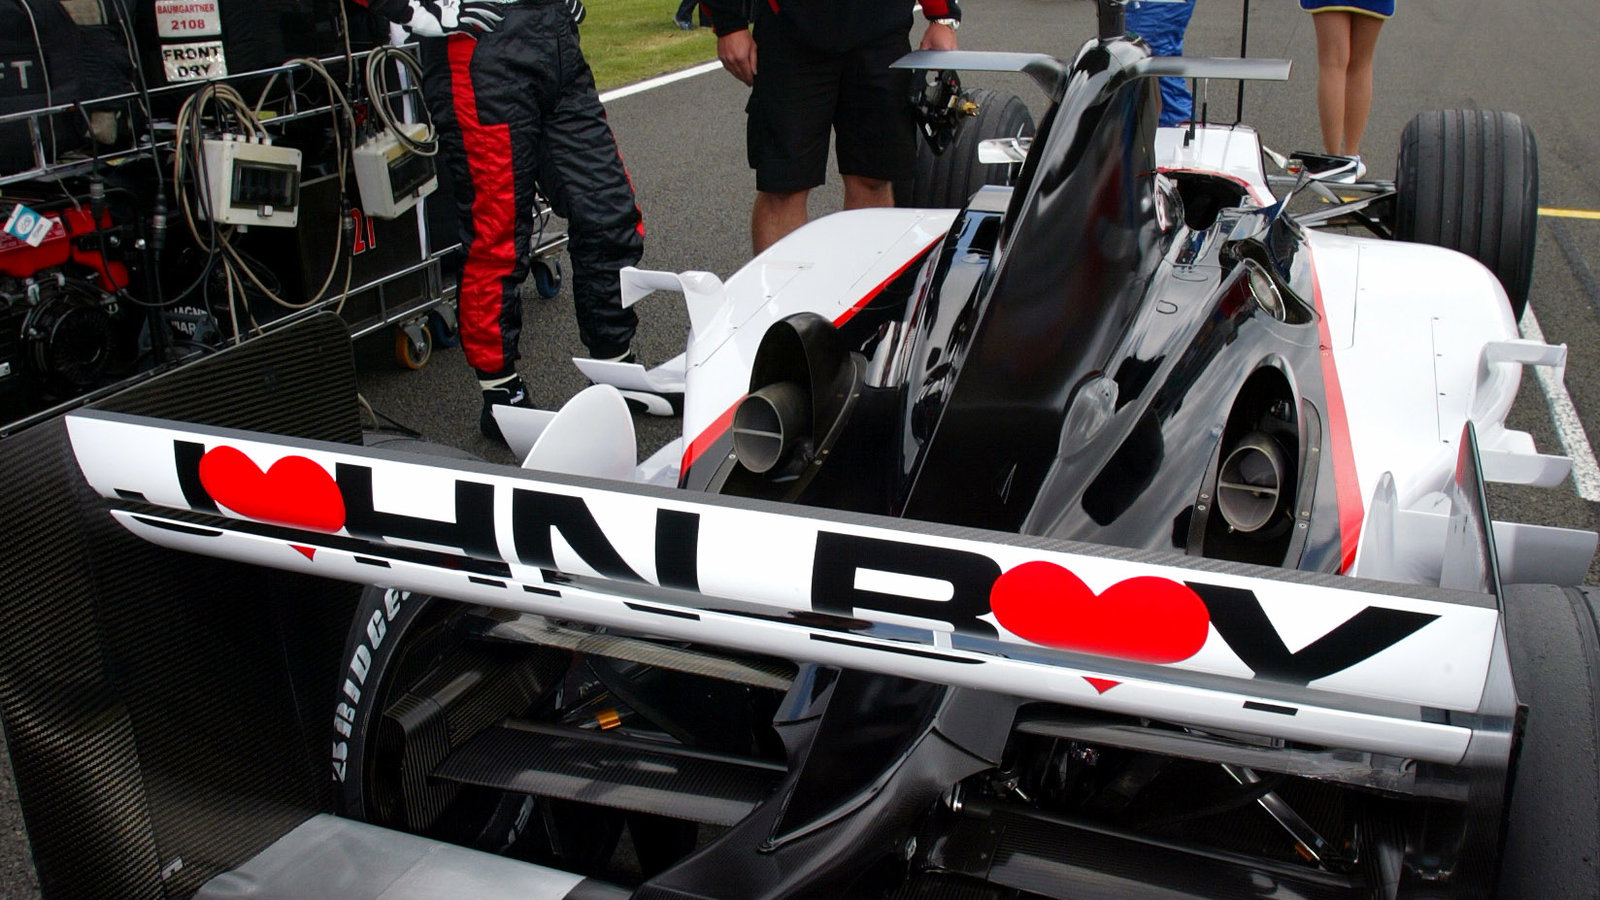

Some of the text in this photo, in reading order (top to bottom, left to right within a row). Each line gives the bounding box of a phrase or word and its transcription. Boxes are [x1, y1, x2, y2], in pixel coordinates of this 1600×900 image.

[157, 4, 215, 14] BAUMGARTNER
[171, 19, 206, 30] 2108
[163, 46, 221, 60] FRONT
[177, 64, 211, 77] DRY
[333, 588, 412, 783] BRIDGE
